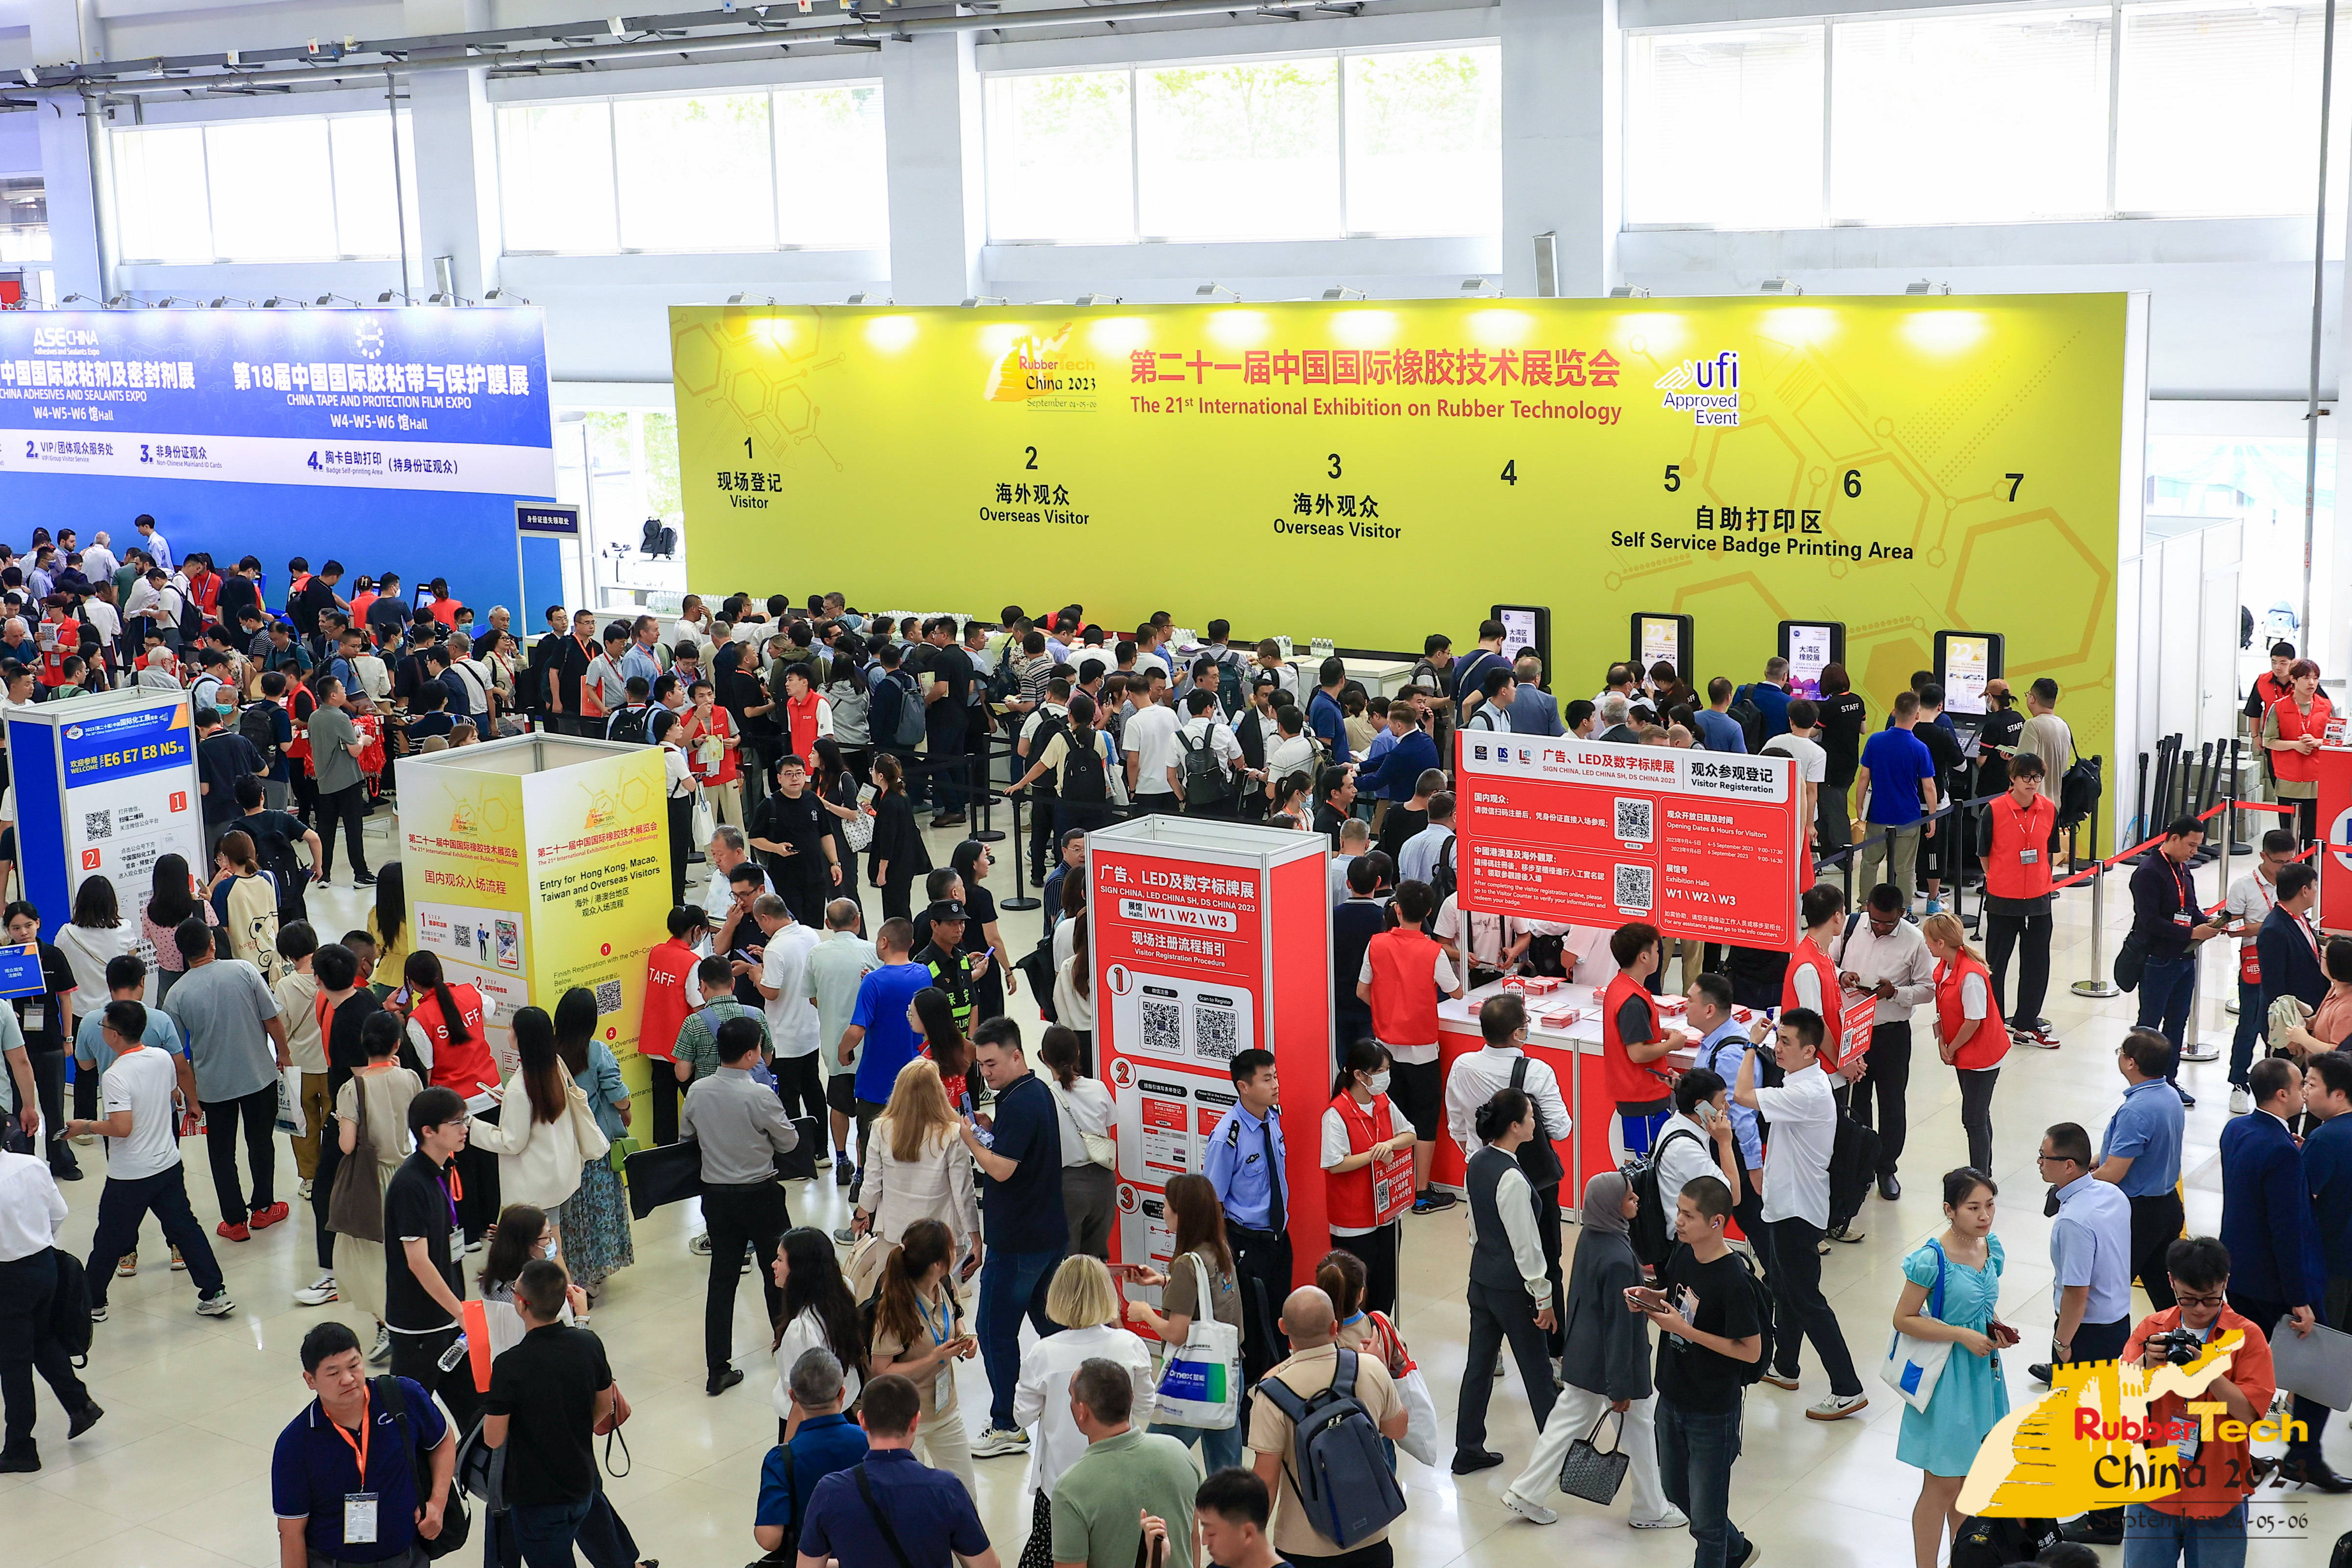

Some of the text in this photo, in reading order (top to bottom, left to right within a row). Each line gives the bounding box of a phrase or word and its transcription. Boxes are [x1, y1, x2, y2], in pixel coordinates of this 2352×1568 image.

[232, 362, 529, 396] 第18届中国国际胶粘带与保护膜展
[1129, 349, 1620, 388] 第二十一届中国国际橡胶技术展览会
[1697, 352, 1737, 388] ufi
[1027, 376, 1096, 391] China 2023
[287, 394, 471, 409] CHINA TAPE AND PROTECTION FILM EXPO
[1130, 396, 1622, 425] The 21st International Exhibition on Rubber Technology
[1664, 392, 1736, 409] Approved
[1696, 410, 1737, 424] Event
[41, 441, 113, 456] VIP/团体观众服务处
[157, 445, 207, 460] 非身份证观众
[325, 451, 382, 466] 胸卡自助打印
[744, 437, 752, 459] 1
[1025, 446, 1038, 470] 2
[1327, 453, 1342, 479] 3
[1500, 459, 1517, 486] 4
[717, 471, 782, 492] 现场登记
[1664, 465, 1681, 492] 5
[1843, 469, 1862, 498] 6
[2005, 474, 2024, 502] 7
[730, 494, 768, 509] Visitor
[996, 483, 1070, 506] 海外观众
[1293, 492, 1379, 518] 海外观众
[527, 515, 569, 526] 身份证遗失领取处
[980, 507, 1089, 524] Overseas Visitor
[1696, 505, 1823, 534] 自助打印区
[1274, 518, 1401, 539] Overseas Visitor
[1611, 531, 1913, 561] Self Service Badge Printing Area
[1841, 703, 1859, 712] STAFF
[2007, 722, 2023, 733] STAFF
[70, 756, 98, 768] 欢迎参观
[104, 752, 121, 767] E6
[123, 748, 139, 763] E7
[142, 745, 158, 760] E8
[160, 741, 178, 757] N5
[1543, 749, 1675, 774] 广告、LED及数字标牌展
[71, 764, 98, 774] WELCOME
[1559, 767, 1581, 776] CHINA,
[1691, 762, 1773, 783] 观众参观登记
[1691, 779, 1773, 793] Visitor Registeration
[119, 813, 144, 823] 扫描二维码
[120, 818, 159, 831] 关注微信公众平台
[1666, 810, 1733, 825] 观众开放日期及时间
[538, 821, 658, 858] 第二十一届中国国际橡胶技术展览会
[1666, 822, 1691, 831] Opening
[1745, 830, 1767, 838] Visitors
[122, 842, 155, 854] 点击公众号下方
[409, 833, 518, 858] 第二十一届中国国际橡胶技术展览会
[86, 852, 97, 868] 2
[1666, 864, 1688, 874] 展馆号
[425, 870, 507, 894] 国内观众入场流程
[540, 856, 658, 890] Entry for Hong Kong, Macao,
[1101, 864, 1255, 899] 广告、LED及数字标牌展
[1666, 876, 1694, 884] Exhibition
[541, 866, 660, 903] Taiwan and Overseas Visitors
[1101, 885, 1118, 894] SIGN
[1120, 887, 1145, 899] CHINA,
[1146, 891, 1160, 900] LED
[1162, 894, 1185, 903] CHINA
[1187, 897, 1200, 906] SH,
[1212, 900, 1237, 910] CHINA
[1238, 903, 1255, 912] 2023
[1128, 902, 1142, 911] 展馆
[1666, 888, 1736, 906] W1 W2 W3
[582, 899, 624, 917] 观众入场流程
[1148, 906, 1227, 928] W1 W2 W3
[1131, 931, 1225, 957] 现场注册流程指引
[1134, 948, 1225, 967] Visitor Registration Procedure
[649, 967, 676, 987] TAFF
[1114, 967, 1124, 992] 1
[1116, 1061, 1129, 1083] 2
[1394, 1178, 1409, 1194] 入场参观
[1121, 1186, 1134, 1209] 3
